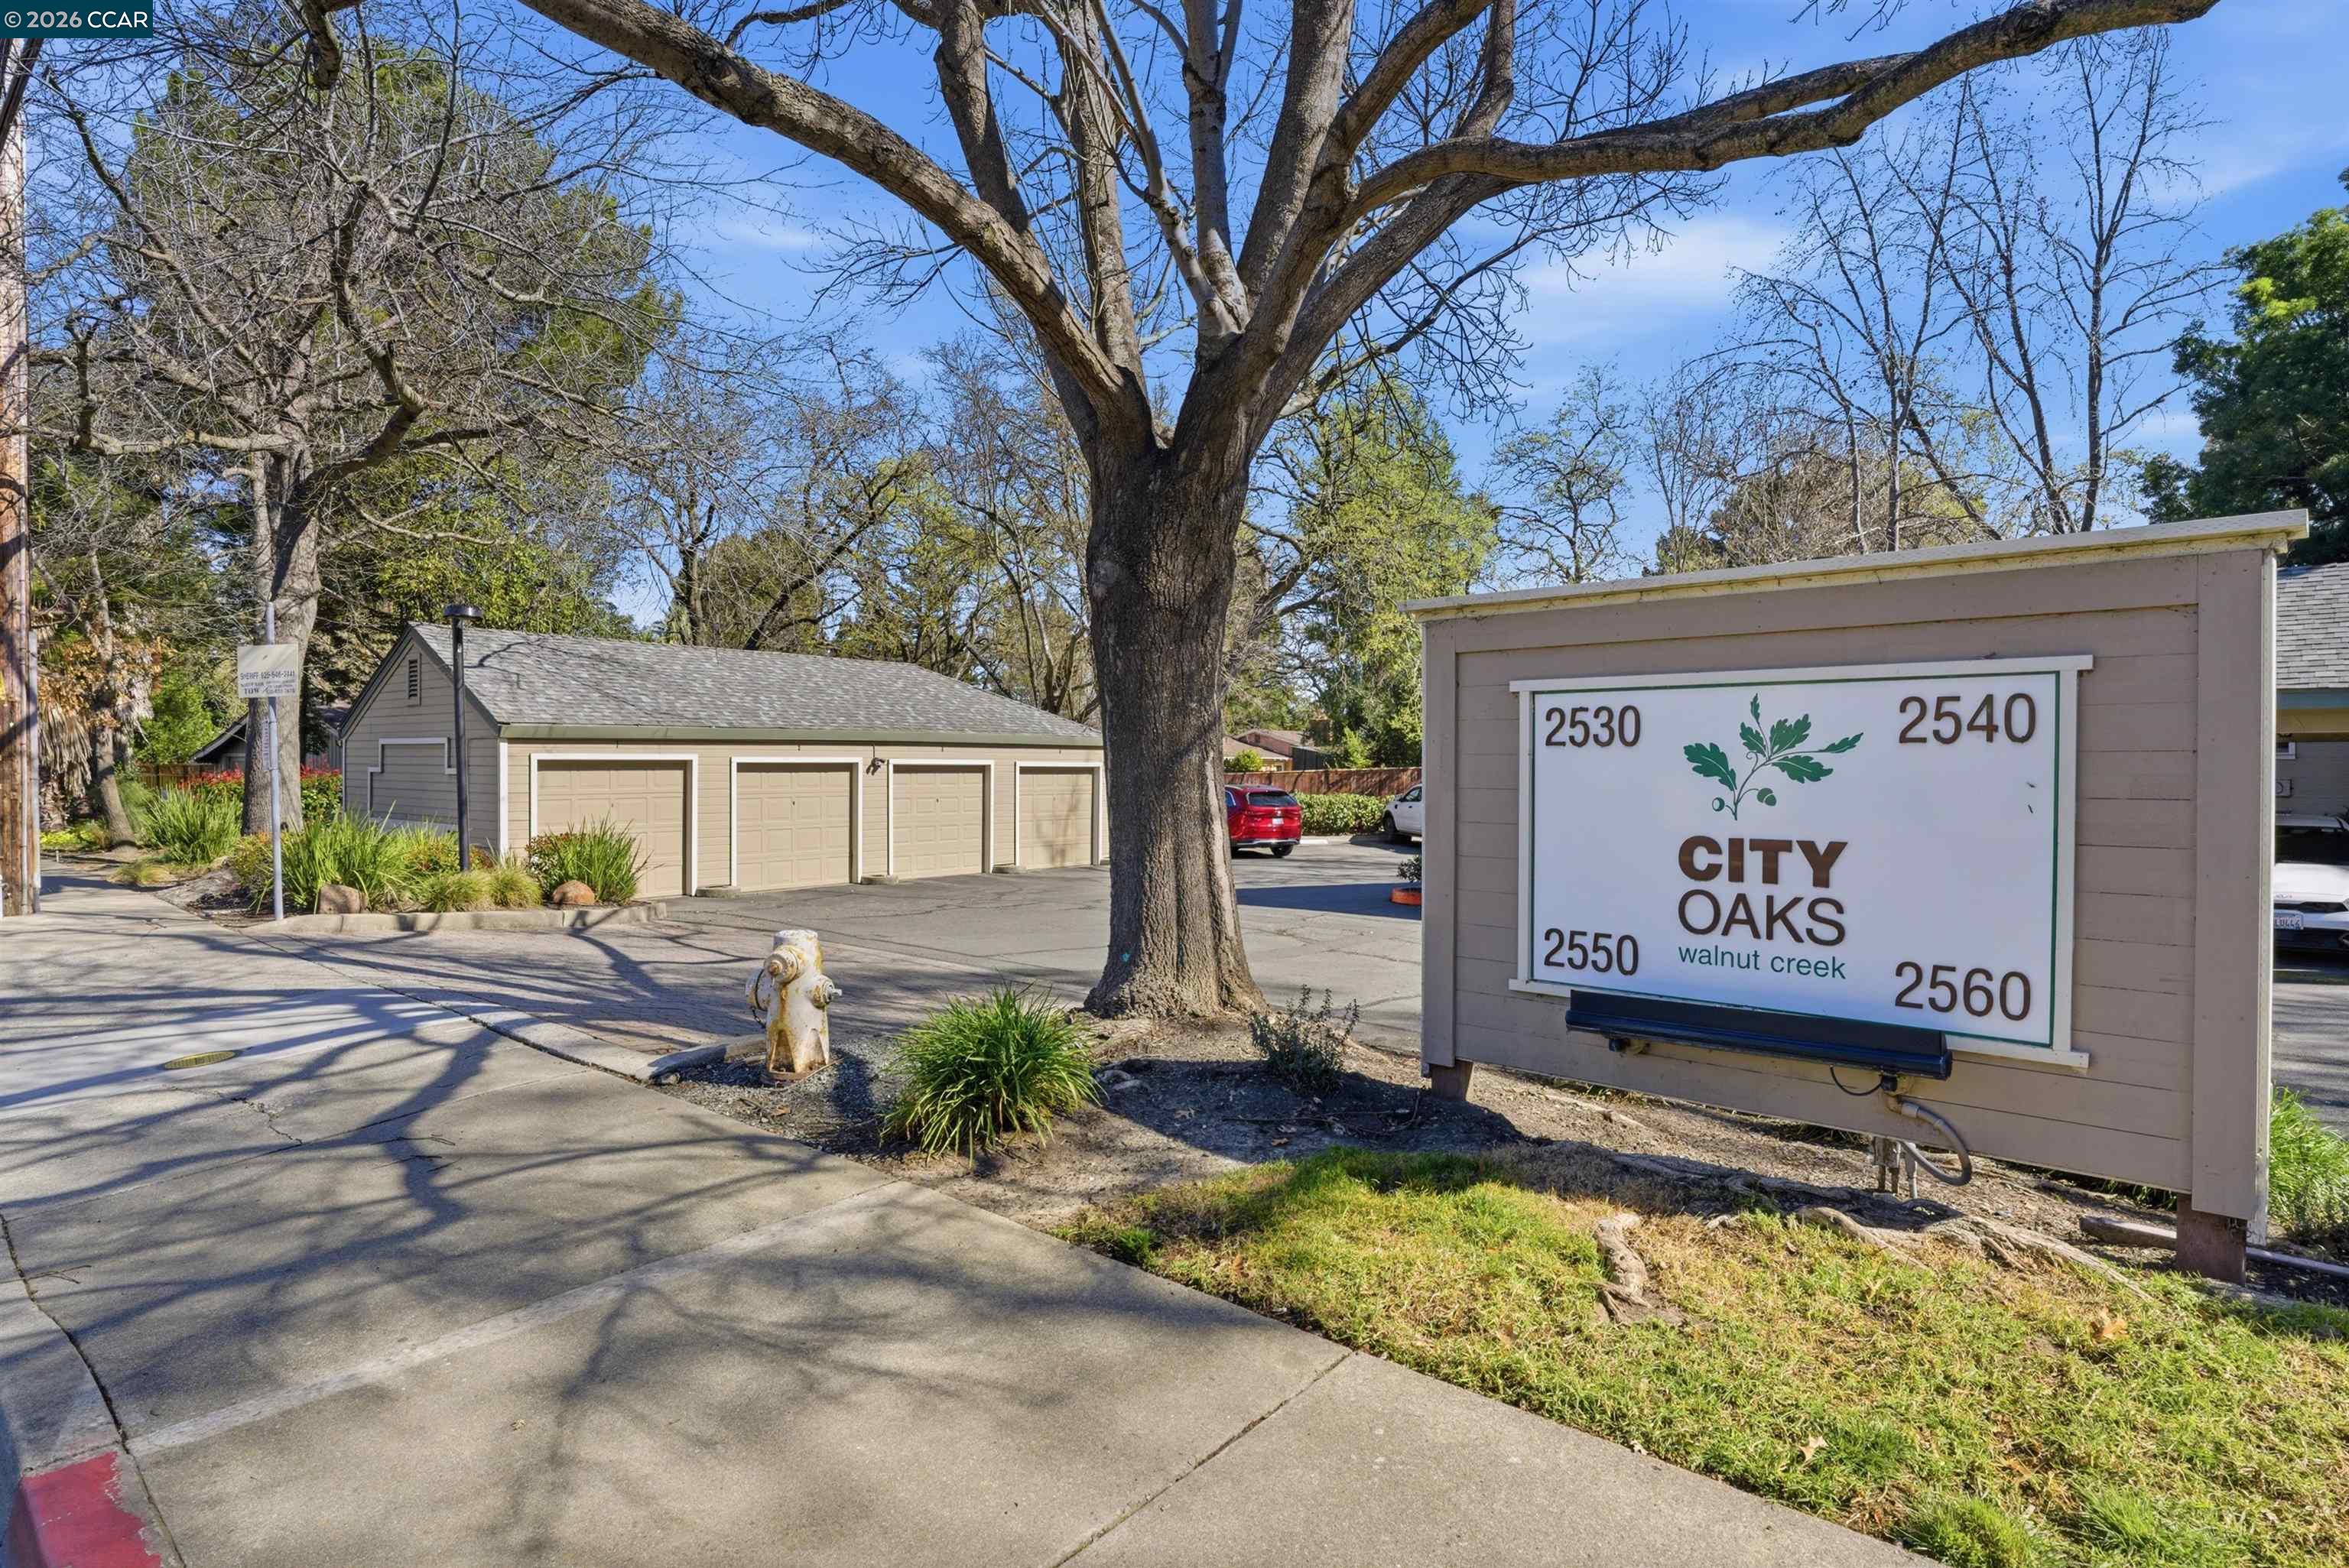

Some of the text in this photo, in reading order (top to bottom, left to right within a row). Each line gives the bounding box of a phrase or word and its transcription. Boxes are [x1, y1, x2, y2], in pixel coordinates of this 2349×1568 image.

[1545, 705, 1641, 748] 2530
[1899, 692, 2036, 745] 2540
[1678, 835, 1848, 889] CITY
[1678, 888, 1846, 947] OAKS
[1543, 927, 1639, 976] 2550
[1678, 944, 1847, 980] walnut creek
[1894, 961, 2032, 1021] 2560
